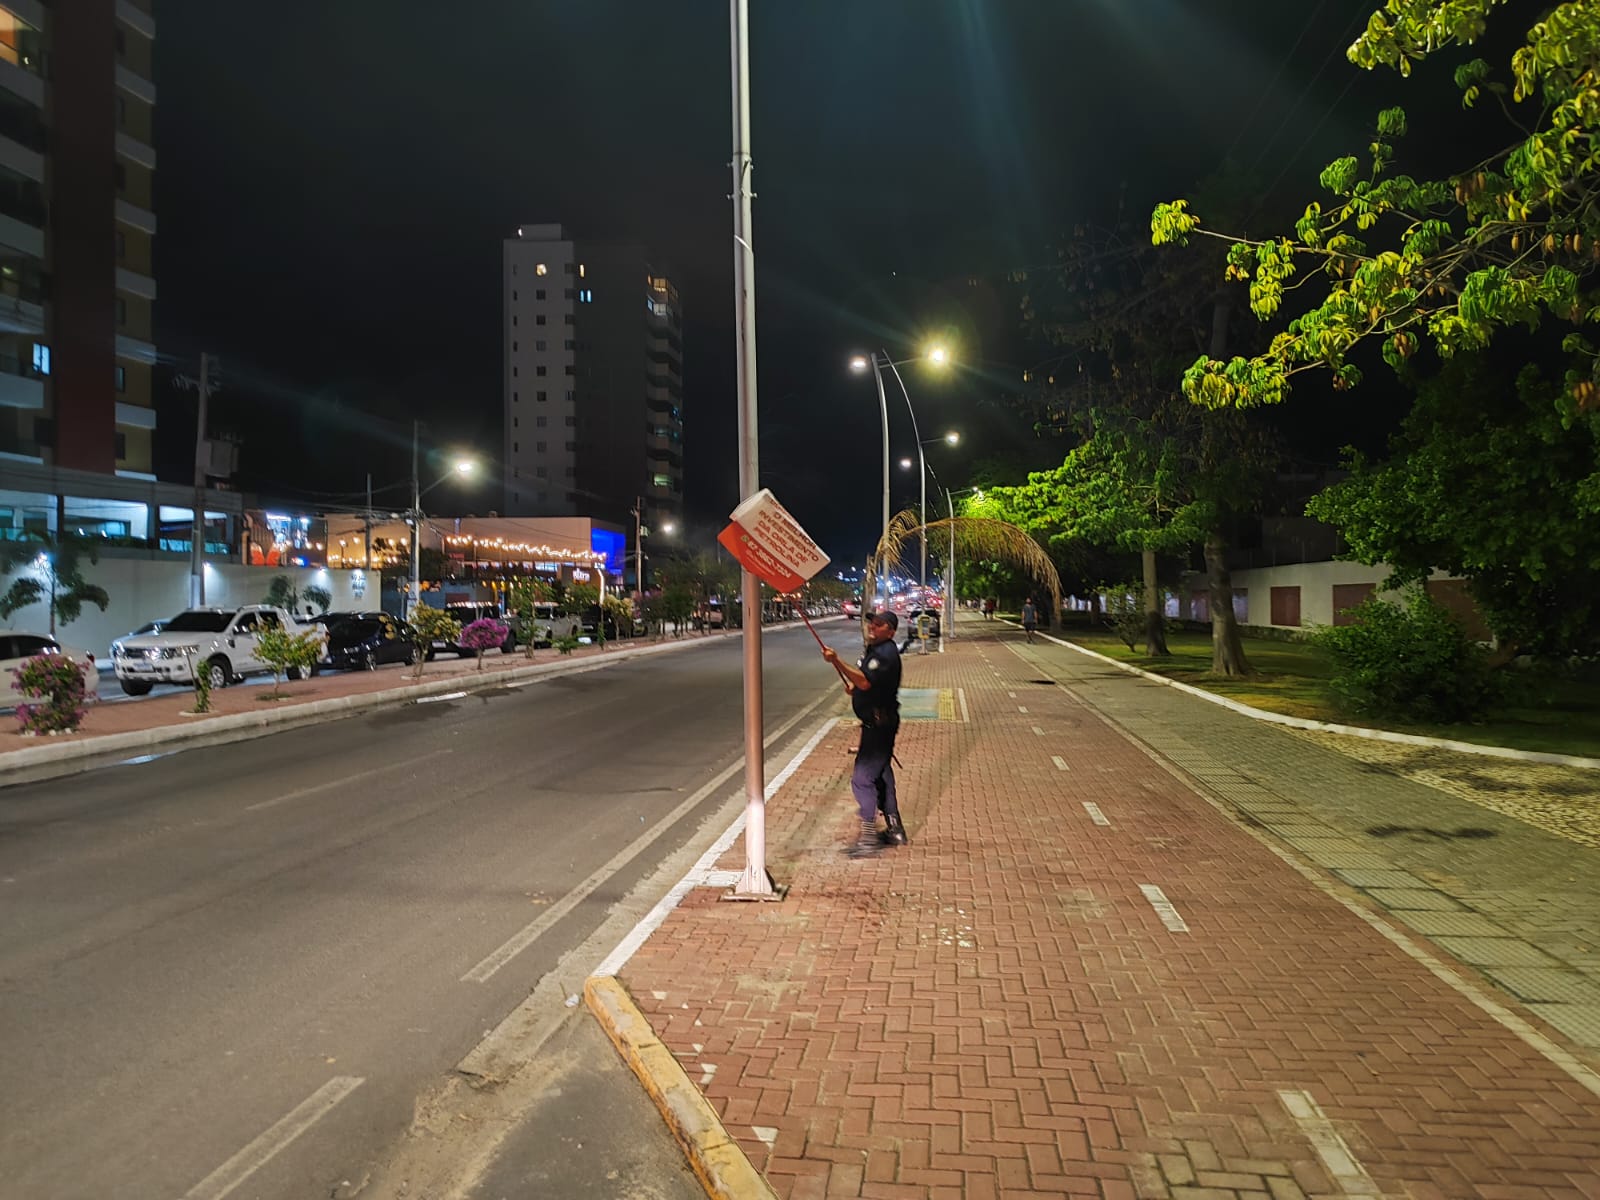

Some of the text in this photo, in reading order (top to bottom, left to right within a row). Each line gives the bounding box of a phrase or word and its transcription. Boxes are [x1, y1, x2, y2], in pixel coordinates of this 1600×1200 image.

[754, 526, 800, 568] PETROLINA
[758, 520, 771, 534] DA
[772, 532, 795, 554] ORLA
[797, 552, 808, 564] DE
[759, 510, 819, 562] INVESTIMENTO
[774, 511, 816, 549] O MELHOR
